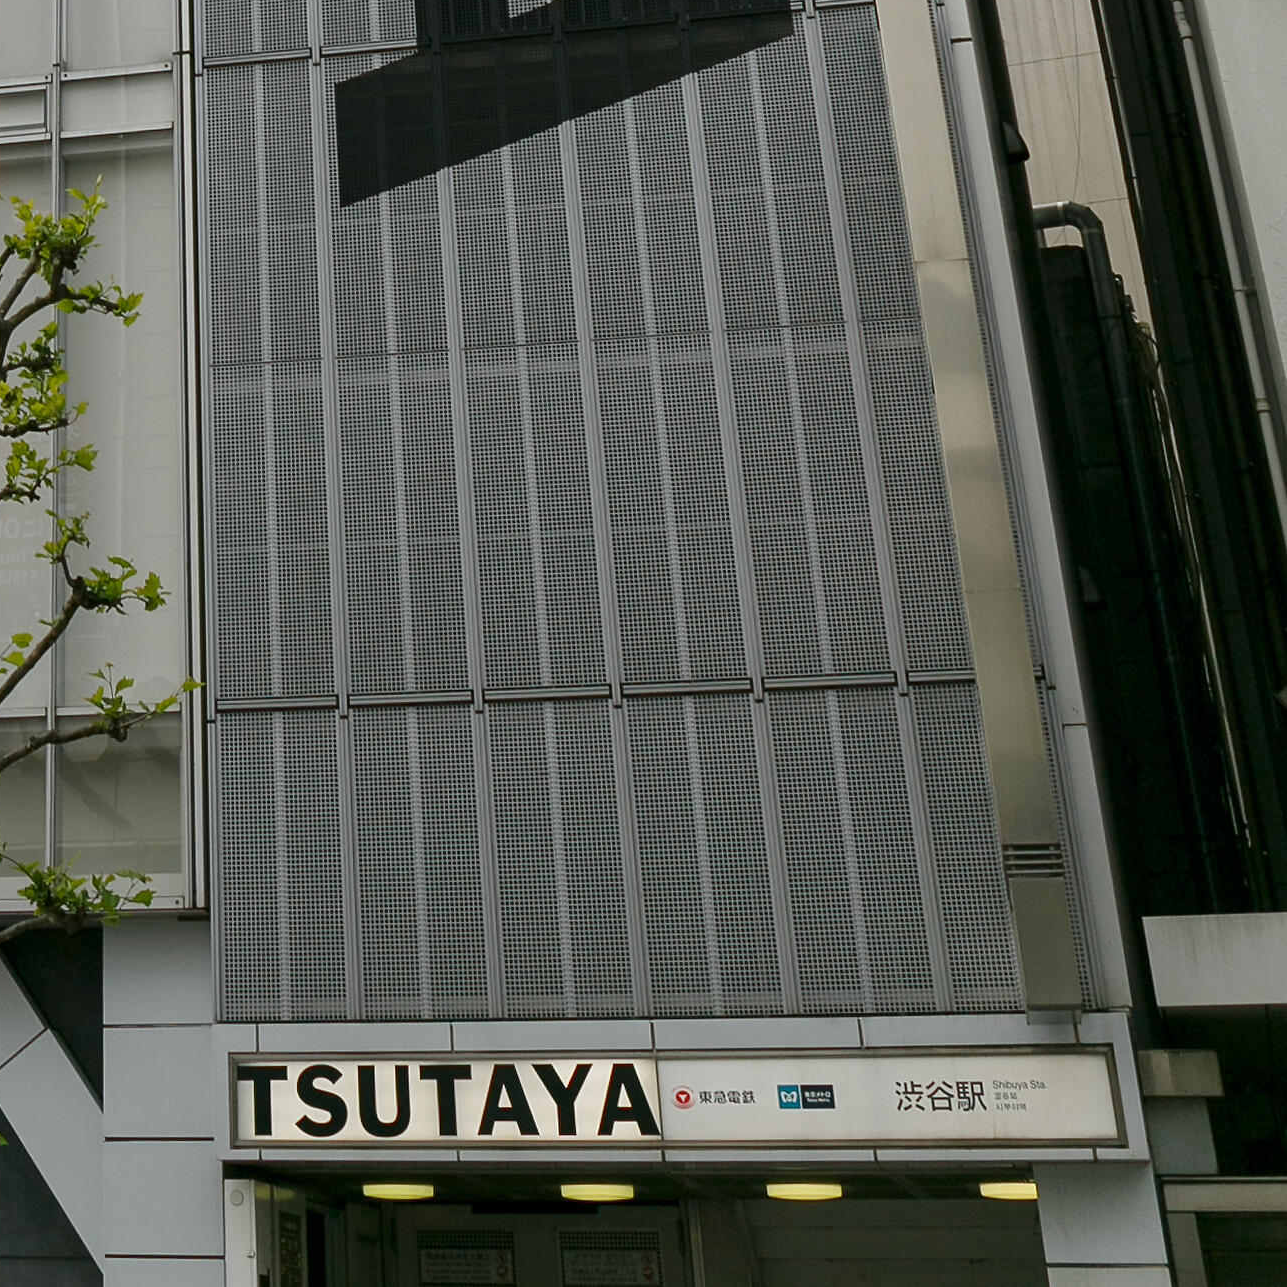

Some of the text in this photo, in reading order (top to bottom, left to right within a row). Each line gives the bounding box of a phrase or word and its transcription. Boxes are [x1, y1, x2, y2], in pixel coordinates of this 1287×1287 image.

[895, 1080, 987, 1112] 渋谷駅
[992, 1079, 1028, 1091] Shibuya
[237, 1063, 661, 1137] TSUTAYA
[699, 1090, 756, 1104] 東急電鉄
